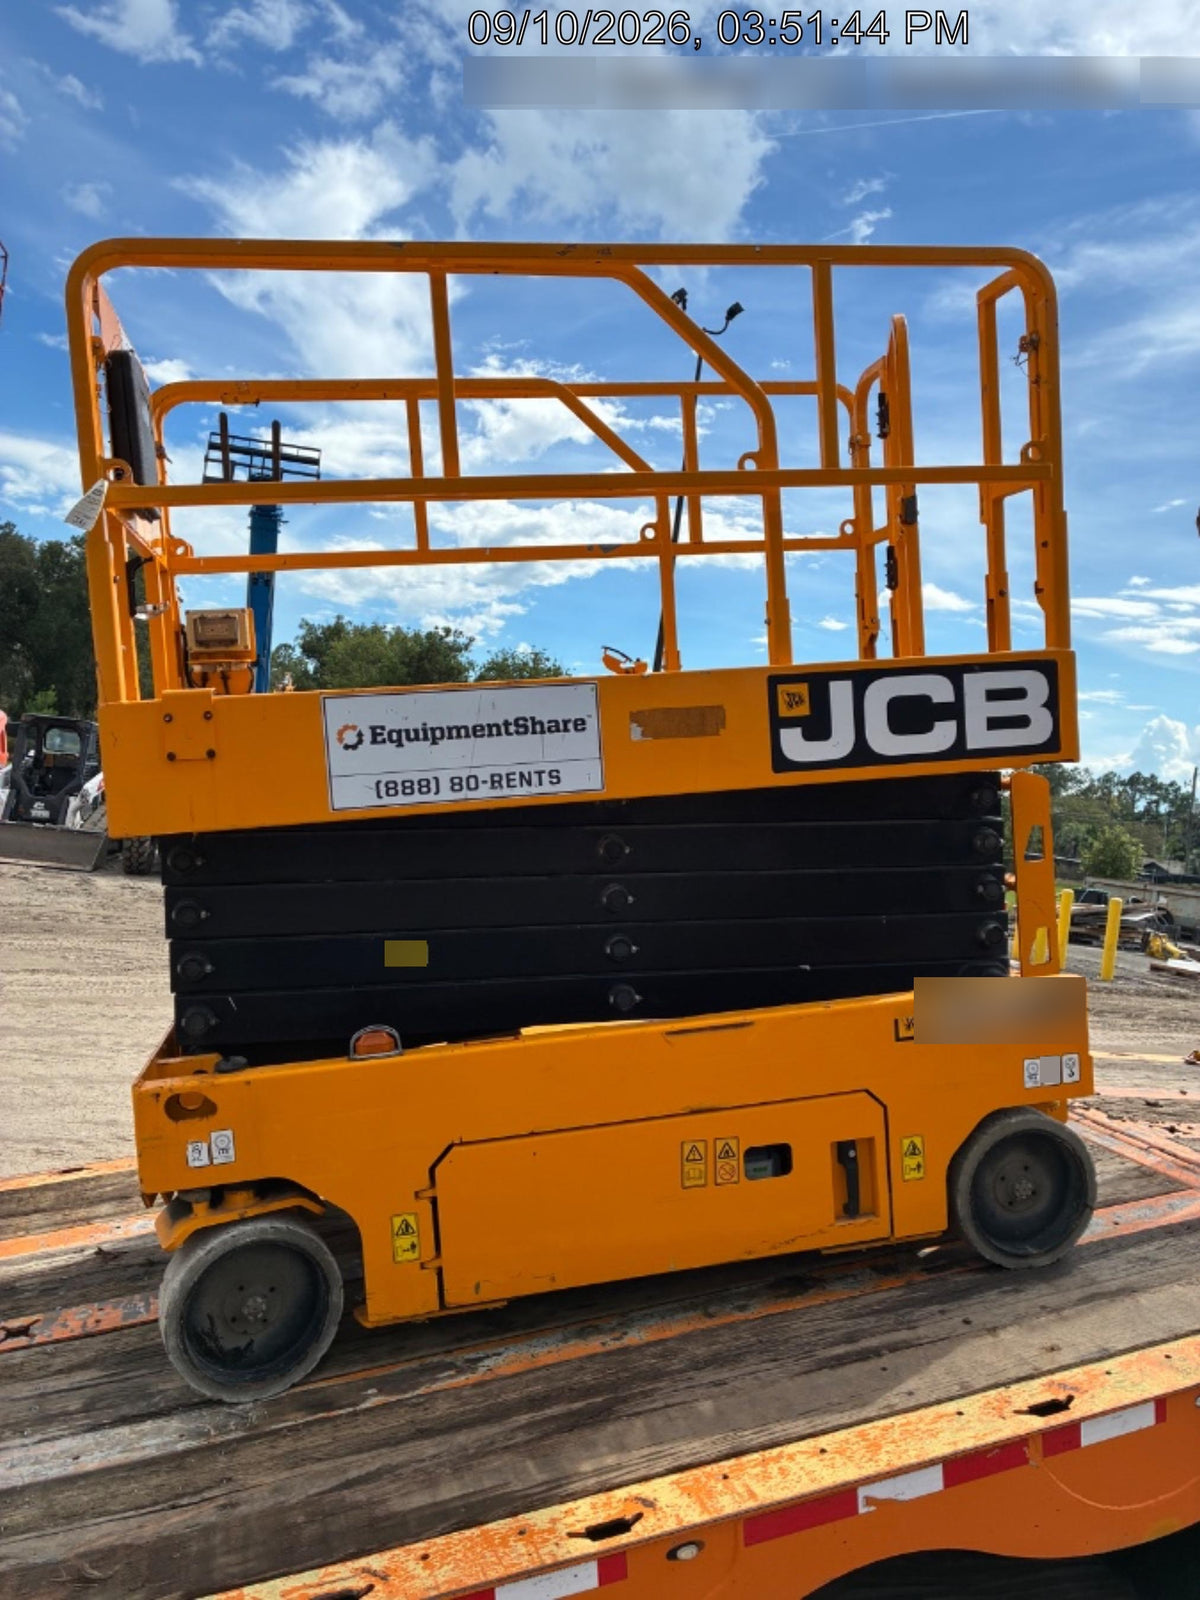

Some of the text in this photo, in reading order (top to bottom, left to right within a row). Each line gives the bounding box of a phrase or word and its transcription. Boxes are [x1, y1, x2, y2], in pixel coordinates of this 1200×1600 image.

[780, 669, 1054, 762] JCB
[375, 769, 562, 800] (888) 80-RENTS
